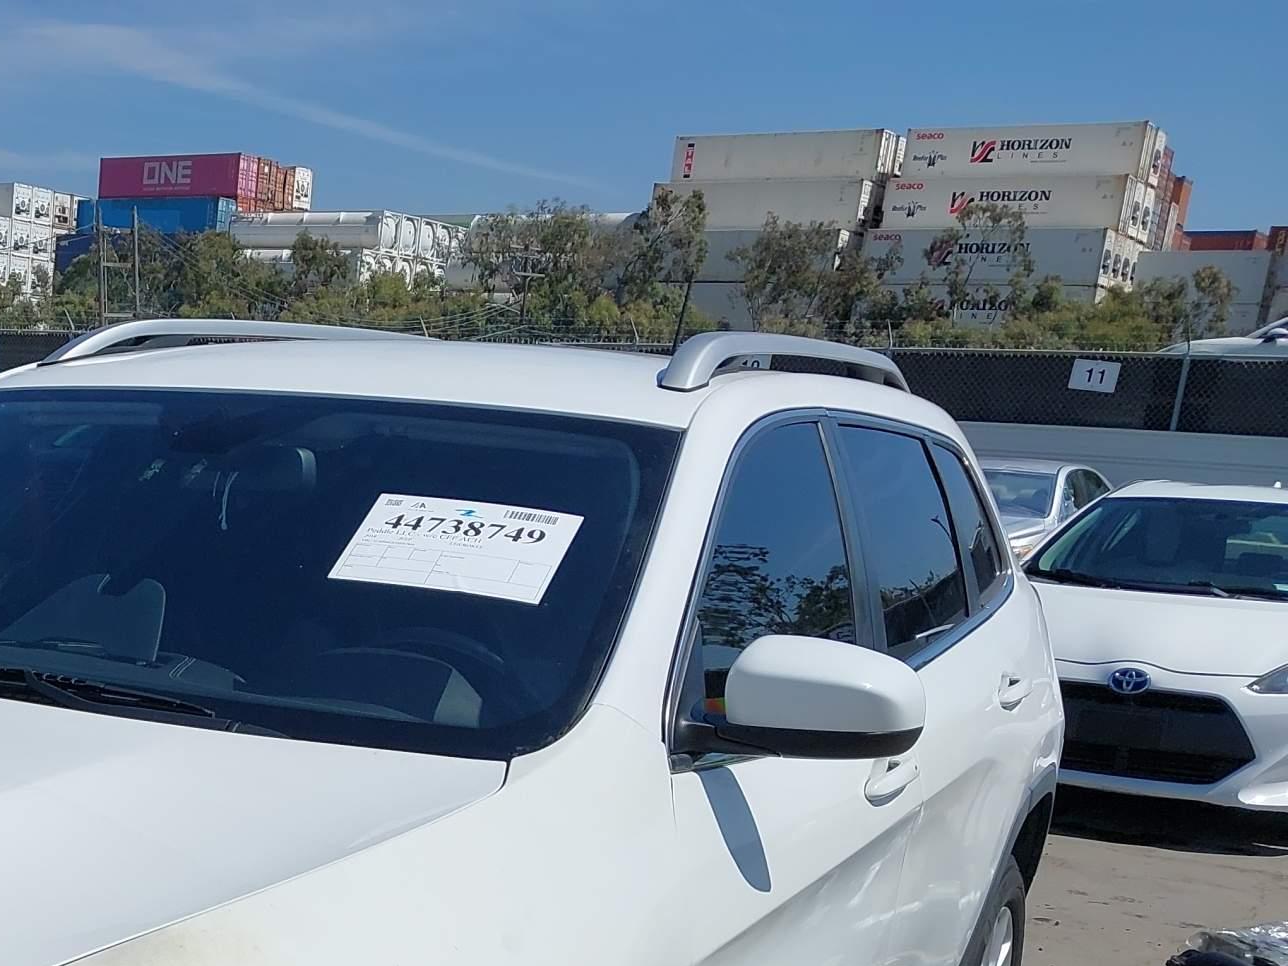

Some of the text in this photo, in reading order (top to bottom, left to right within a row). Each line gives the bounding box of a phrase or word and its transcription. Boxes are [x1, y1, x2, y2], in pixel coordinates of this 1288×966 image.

[915, 132, 944, 140] seaco
[998, 138, 1072, 151] HORIZON
[997, 151, 1059, 160] LINES
[143, 160, 193, 185] ONE
[895, 182, 924, 190] seaco
[978, 190, 1052, 202] HORIZON
[872, 232, 902, 241] seaco
[1085, 367, 1106, 385] 11
[384, 513, 547, 545] 44738749
